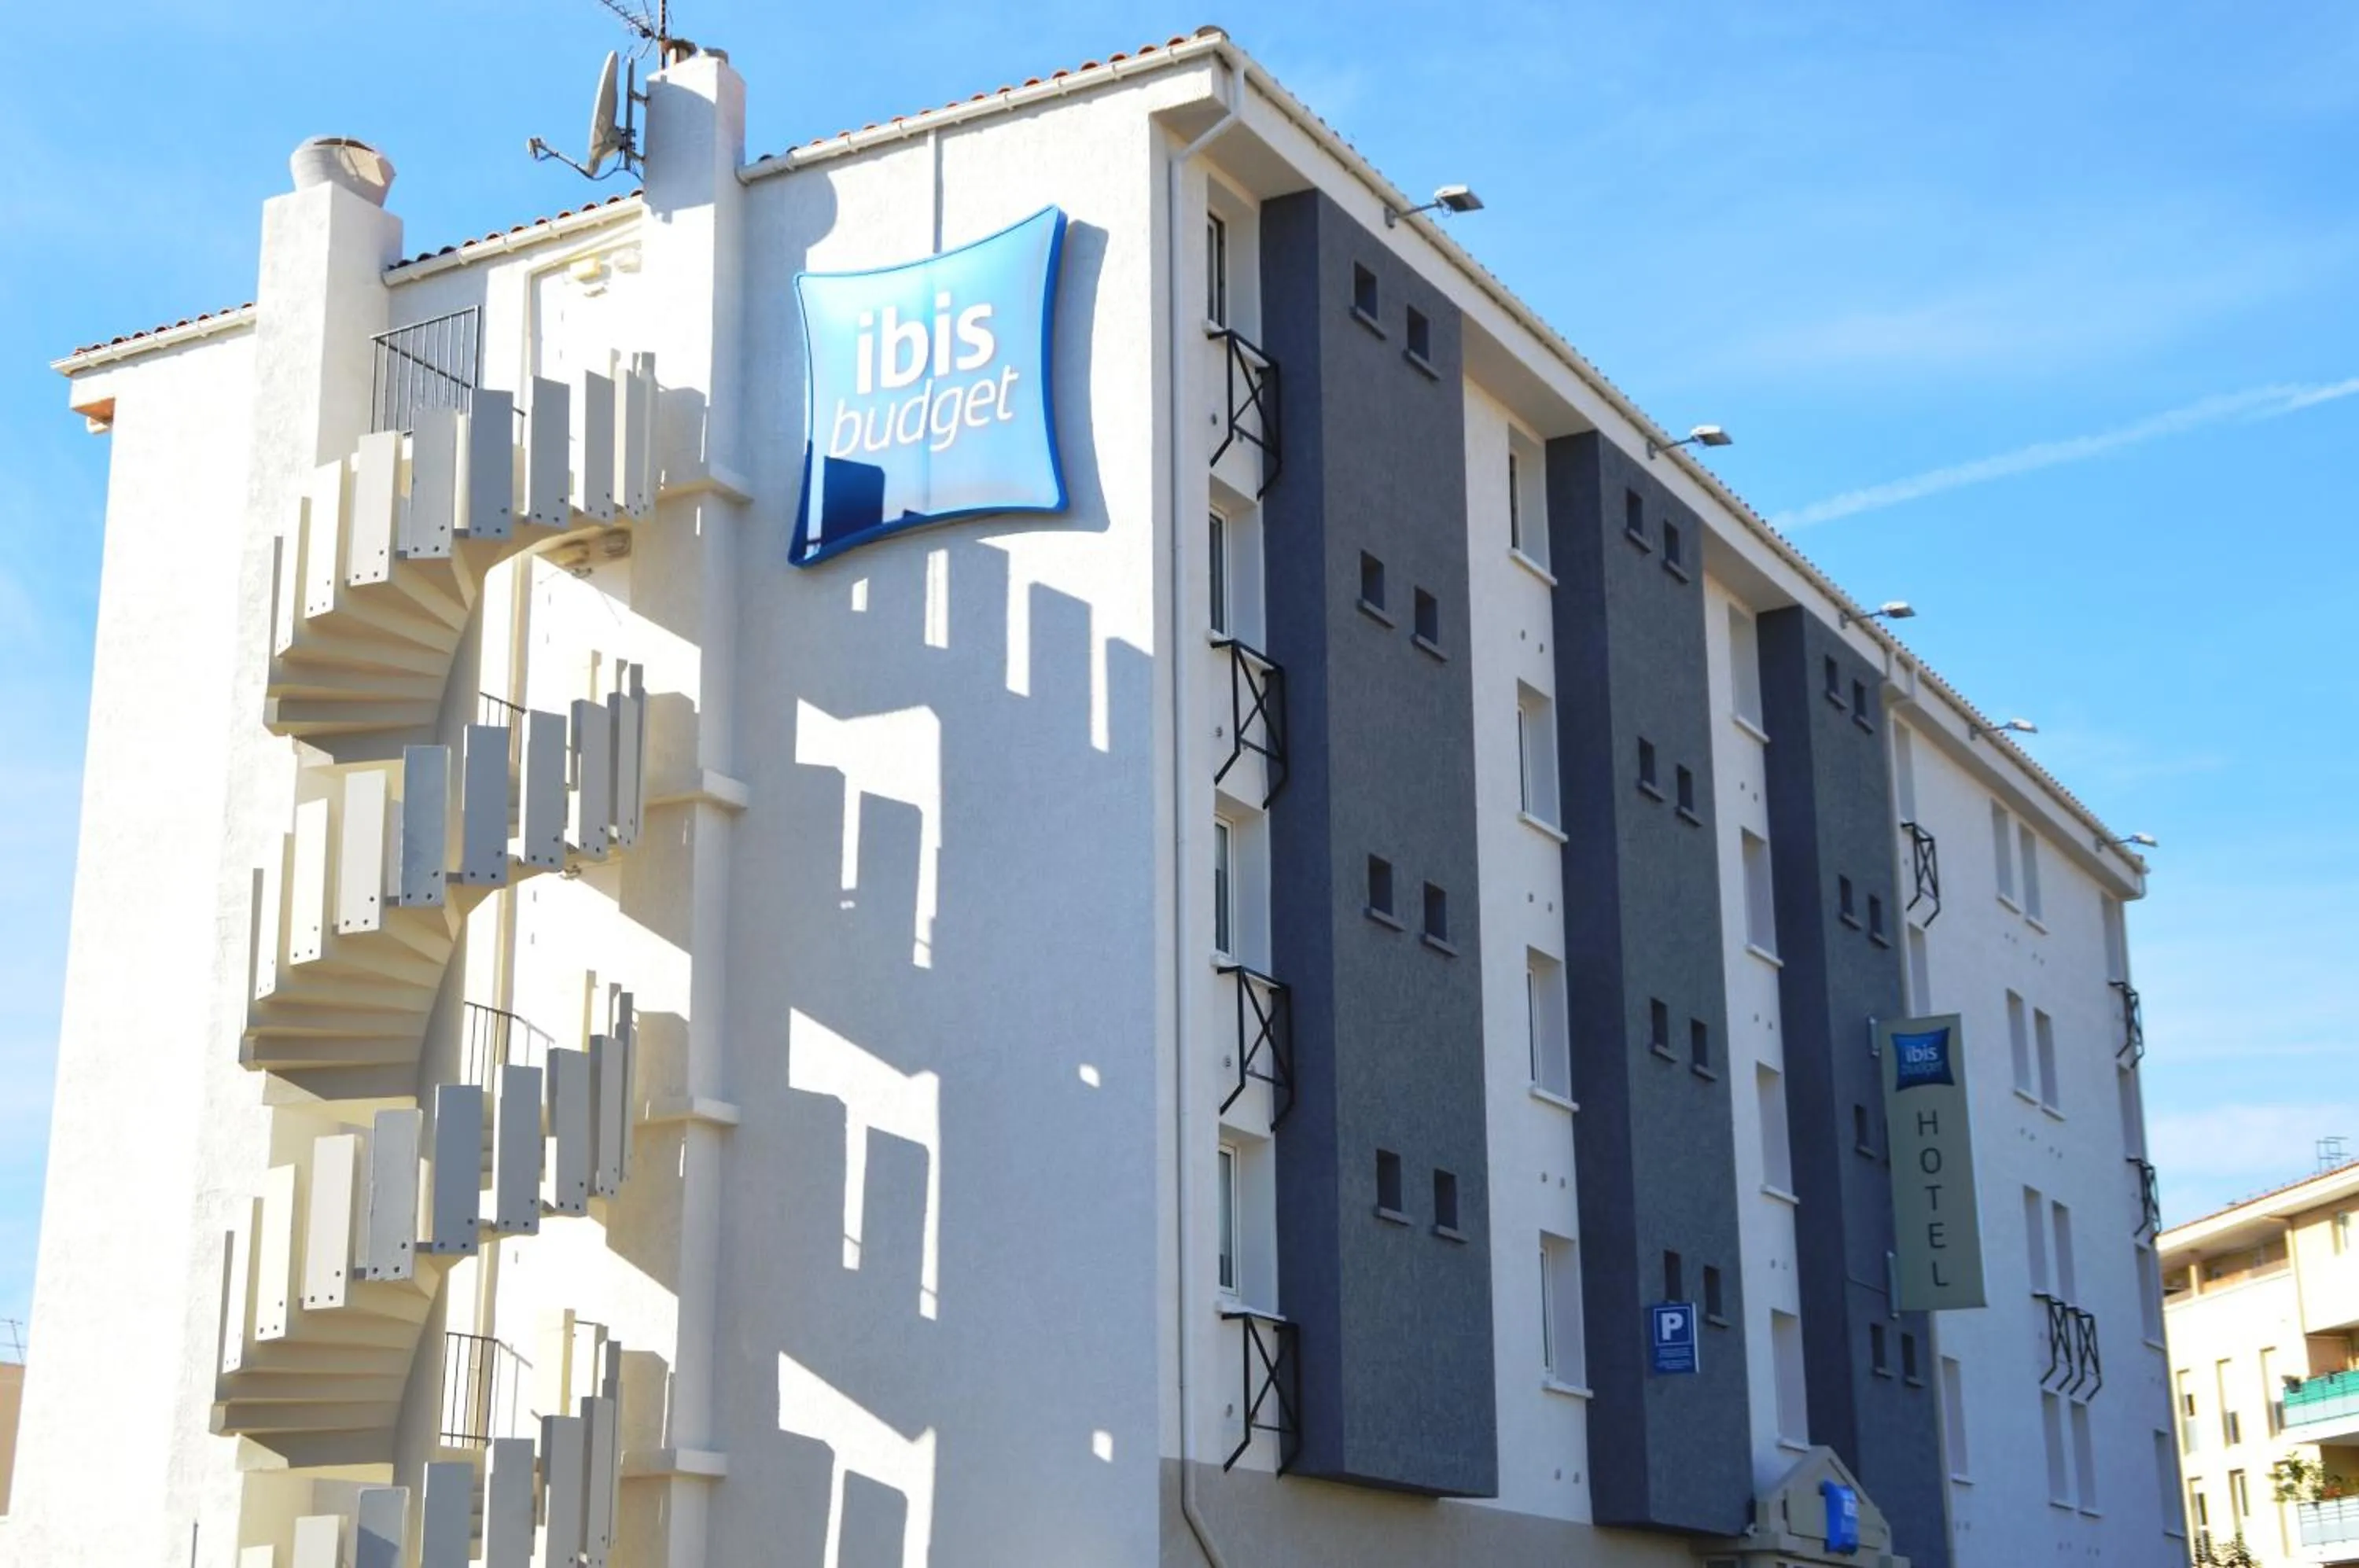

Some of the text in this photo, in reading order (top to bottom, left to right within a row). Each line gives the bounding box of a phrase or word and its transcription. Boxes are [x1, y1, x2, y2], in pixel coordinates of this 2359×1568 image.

[856, 291, 995, 395] ibis
[829, 365, 1019, 458] budget
[1904, 1043, 1938, 1063] ibis
[1917, 1110, 1950, 1287] HOTEL
[1661, 1312, 1684, 1341] P
